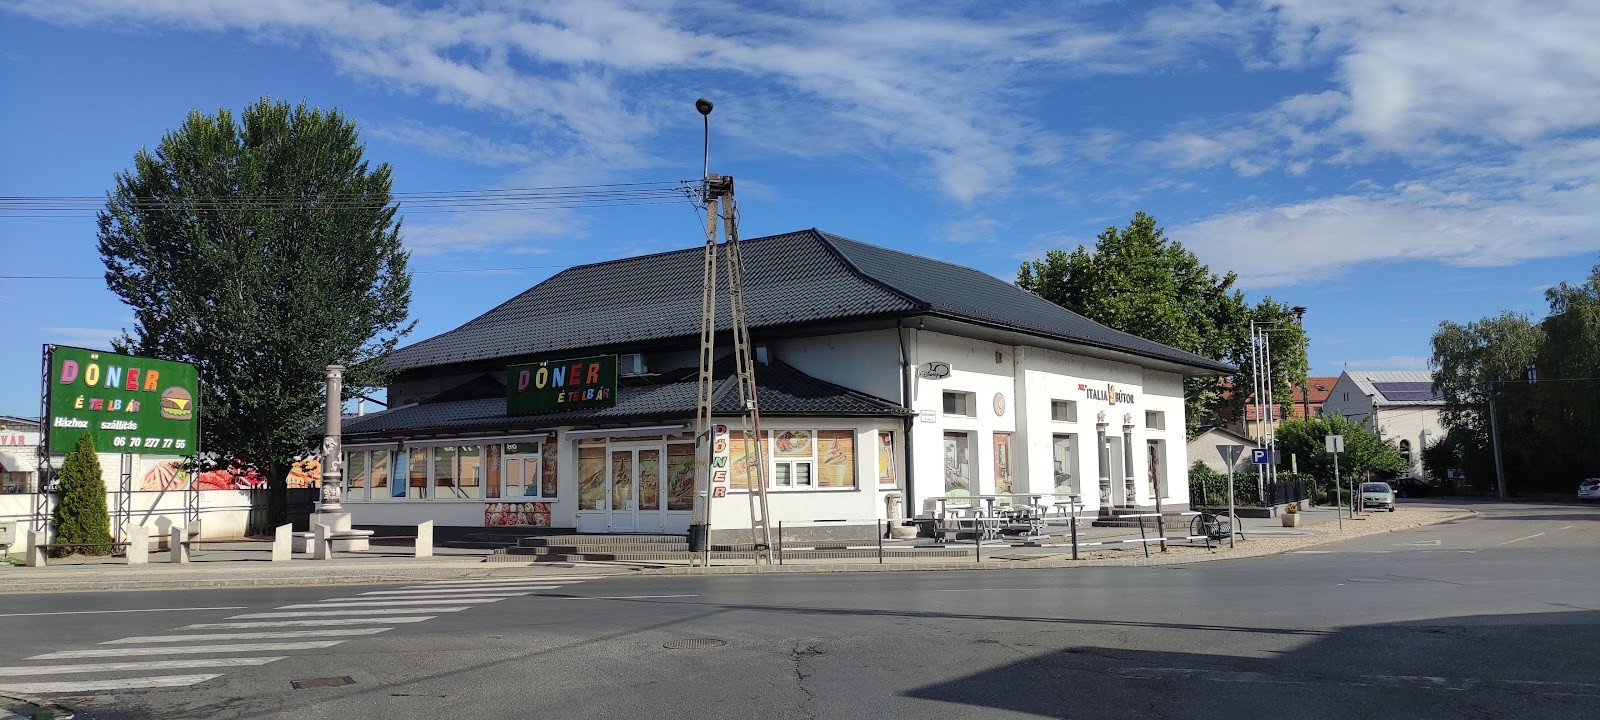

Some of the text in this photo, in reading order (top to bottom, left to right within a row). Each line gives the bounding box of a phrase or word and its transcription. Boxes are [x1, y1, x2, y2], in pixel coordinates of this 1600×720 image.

[60, 354, 160, 391] DÖNER
[518, 360, 601, 391] DÖNER
[1086, 388, 1108, 401] ITALIA
[1114, 389, 1134, 404] BÚTOR
[54, 417, 138, 430] Házhoz szállítás
[113, 436, 186, 448] 06 70 277 77 55
[713, 425, 727, 498] DÖNER
[1254, 450, 1264, 462] P
